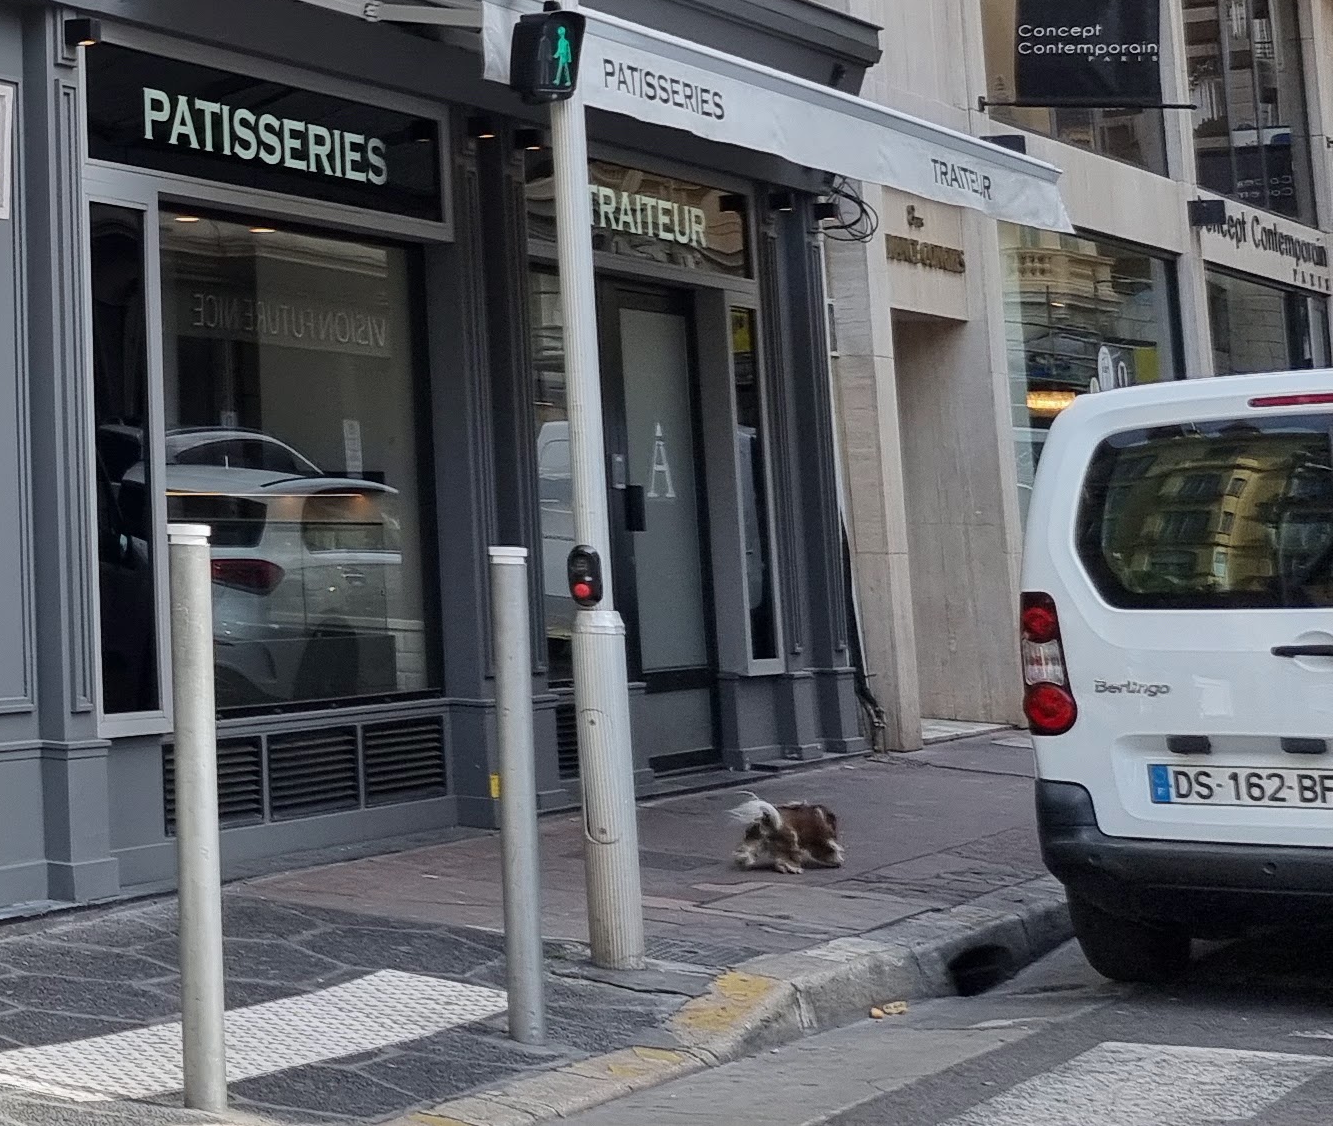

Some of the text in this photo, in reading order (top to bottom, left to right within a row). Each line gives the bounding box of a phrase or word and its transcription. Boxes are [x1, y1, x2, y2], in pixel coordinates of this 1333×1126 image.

[1018, 24, 1102, 38] Concept
[1018, 41, 1158, 56] Contemporain
[603, 58, 725, 120] PATISSERIES
[143, 87, 388, 185] PATISSERIES
[1094, 680, 1171, 697] Berlingo
